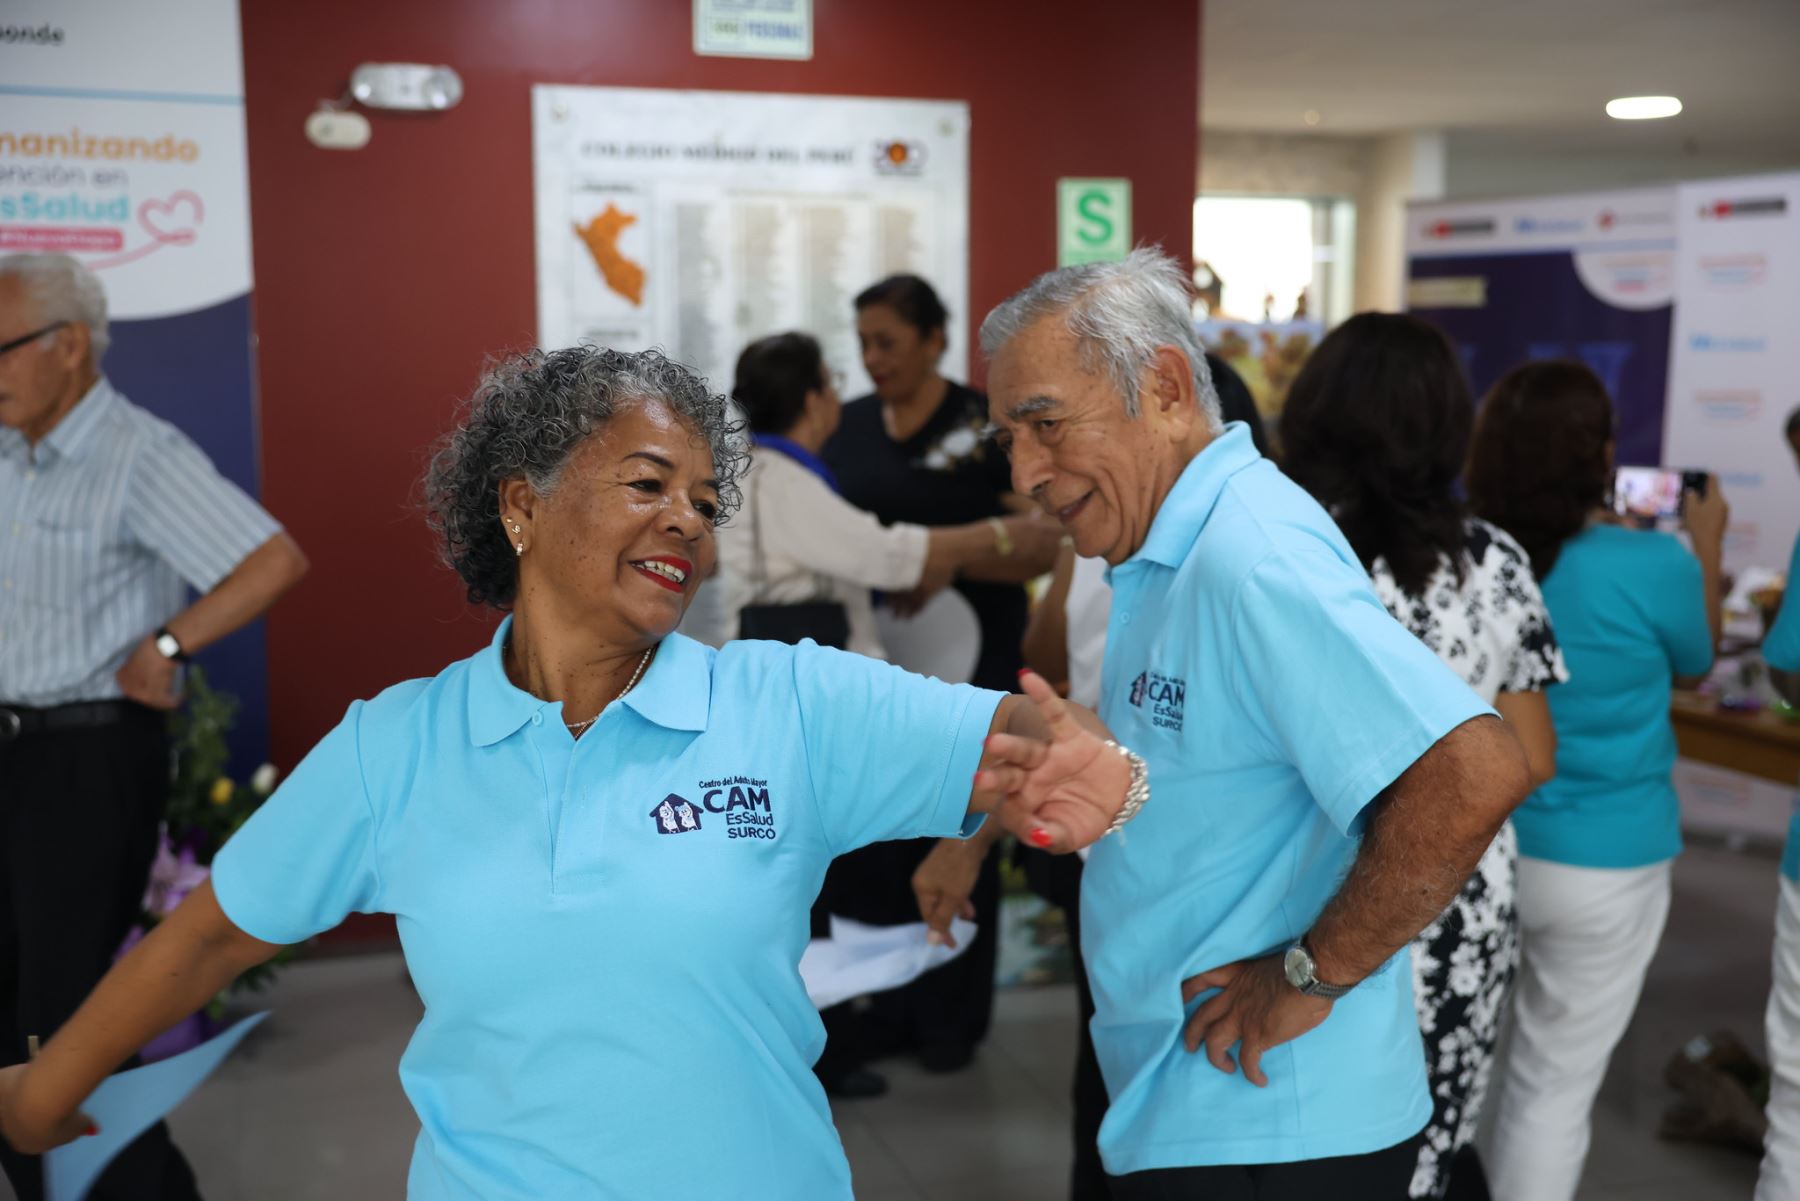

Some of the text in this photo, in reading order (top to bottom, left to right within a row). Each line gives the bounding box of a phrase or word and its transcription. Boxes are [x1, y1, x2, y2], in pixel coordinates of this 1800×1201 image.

[1077, 188, 1114, 247] S
[699, 780, 721, 788] Centro
[722, 777, 733, 786] del
[703, 786, 771, 813] CAM
[726, 811, 774, 826] EsSalud
[727, 827, 776, 839] SURCO
